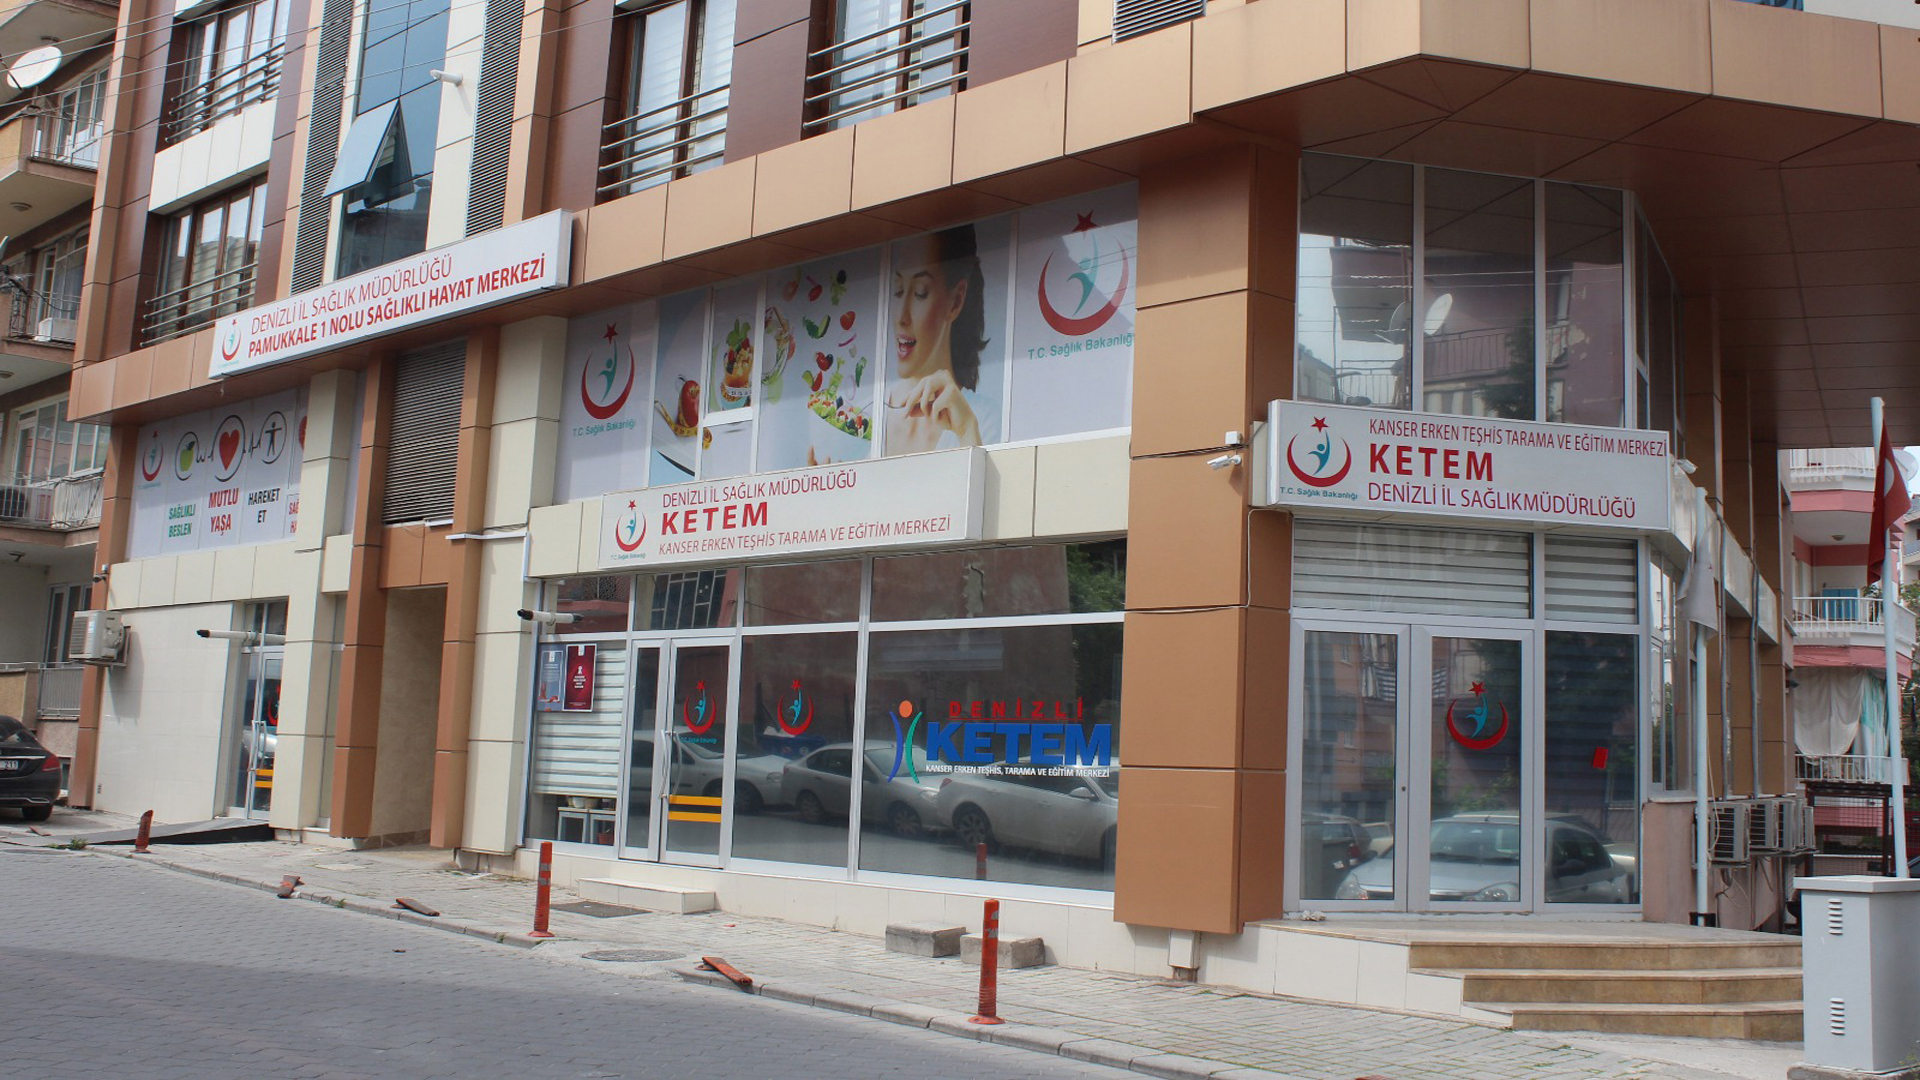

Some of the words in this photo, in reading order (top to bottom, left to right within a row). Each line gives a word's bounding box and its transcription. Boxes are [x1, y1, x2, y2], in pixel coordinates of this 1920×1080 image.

[248, 323, 318, 358] PAMUKKALE
[321, 321, 326, 338] 1
[330, 310, 365, 336] NOLU
[366, 291, 426, 326] SAĞLIKLI
[429, 277, 474, 309] HAYAT
[477, 252, 545, 295] MERKEZİ
[251, 302, 296, 335] DENİZLİ
[298, 299, 308, 321] İL
[311, 290, 356, 317] SAĞLIK
[358, 253, 452, 300] MÜDÜRLÜĞÜ
[1050, 341, 1082, 357] Sağlık
[1085, 333, 1135, 350] Bakanlığ
[1369, 418, 1417, 438] KANSER
[1421, 422, 1459, 441] ERKEN
[1462, 425, 1502, 447] TEŞHİS
[1505, 429, 1555, 449] TARAMA
[1556, 434, 1572, 450] VE
[1574, 433, 1615, 453] EĞİTİM
[1617, 438, 1667, 457] MERKEZİ
[1369, 443, 1493, 482] KETEM
[208, 487, 240, 509] MUTLU
[248, 487, 281, 506] HAREKET
[662, 486, 707, 508] DENİZLİ
[709, 486, 720, 503] İL
[722, 482, 766, 502] SAĞLIK
[768, 469, 857, 497] MÜDÜRLÜĞÜ
[1297, 487, 1321, 497] Sağlık
[1322, 490, 1358, 501] Bakanlığı
[1368, 482, 1436, 505] DENİZLİ
[1442, 484, 1456, 506] İL
[168, 503, 196, 520] SAĞLIKLI
[257, 510, 268, 523] ET
[661, 501, 768, 536] KETEM
[168, 523, 193, 538] BESLEN
[210, 513, 232, 536] YAŞA
[659, 540, 699, 555] KANSER
[701, 536, 735, 552] ERKEN
[737, 531, 775, 550] TEŞHİS
[777, 528, 827, 547] TARAMA
[829, 526, 845, 541] VE
[847, 521, 891, 540] EĞİTİM
[893, 514, 951, 536] MERKEZİ
[950, 697, 1084, 718] DENİZLİ
[926, 721, 1112, 766] KETEM
[925, 764, 953, 773] KANSER
[954, 765, 976, 774] ERKEN
[977, 765, 1003, 777] TEŞHİS,
[1004, 767, 1036, 776] TARAMA
[1037, 768, 1048, 776] VE
[1048, 766, 1074, 777] EĞİTİM
[1075, 767, 1110, 778] MERKEZİ
